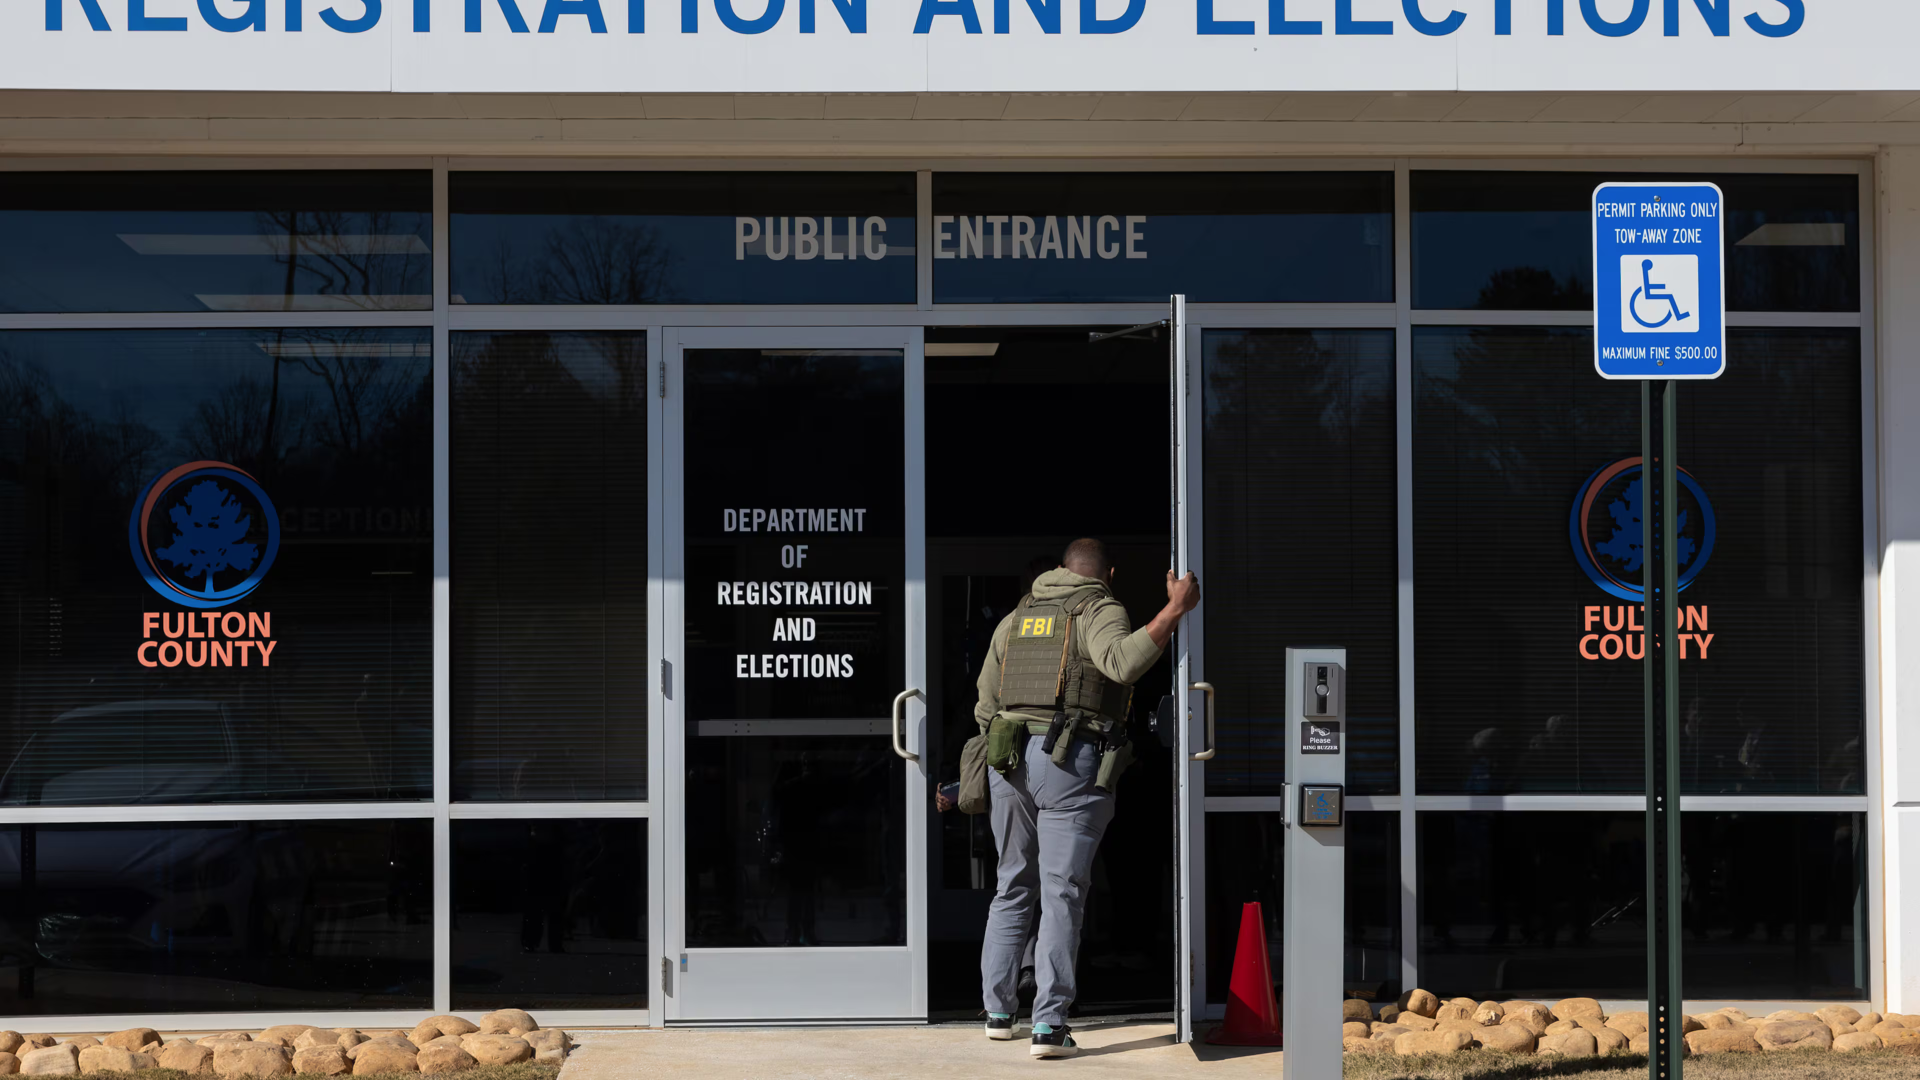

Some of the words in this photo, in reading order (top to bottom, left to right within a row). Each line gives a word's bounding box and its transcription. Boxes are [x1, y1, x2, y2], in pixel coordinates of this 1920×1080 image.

[1597, 202, 1636, 218] PERMIT
[1640, 202, 1686, 218] PARKING
[1690, 202, 1718, 218] ONLY
[735, 215, 887, 261] PUBLIC
[933, 214, 1148, 260] ENTRANCE
[1614, 228, 1668, 244] TOW-AWAY
[1672, 228, 1702, 244] ZONE
[1602, 346, 1646, 360] MAXIMUM
[1650, 346, 1671, 360] FINE
[1674, 346, 1718, 360] $500.00
[723, 508, 867, 532] DEPARTMENT
[781, 544, 809, 569] OF
[717, 581, 872, 606] REGISTRATION
[143, 611, 271, 639] FULTON
[772, 617, 816, 642] AND
[1021, 617, 1053, 636] FBI
[1584, 605, 1708, 632] FULN
[137, 640, 277, 668] COUNTY
[1579, 633, 1715, 660] COUTY
[736, 653, 854, 679] ELECTIONS
[1309, 736, 1331, 744] Please
